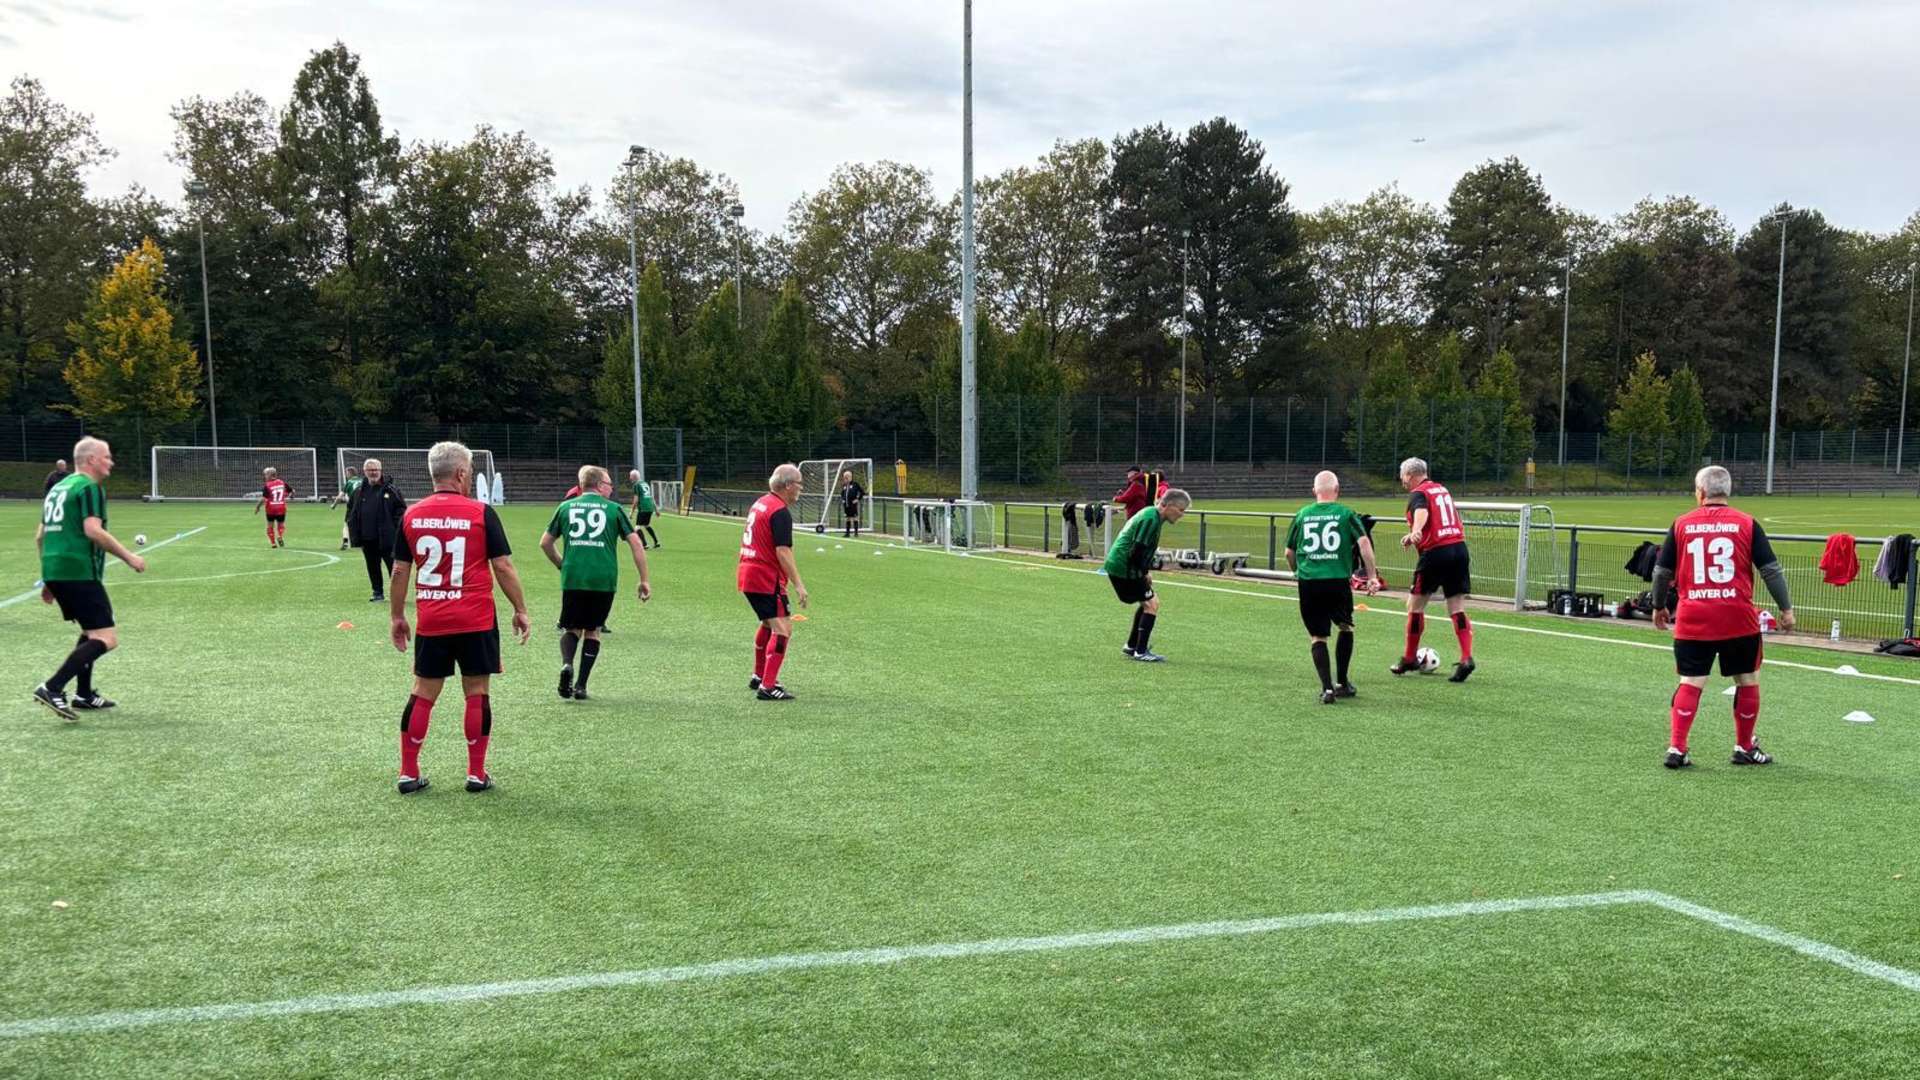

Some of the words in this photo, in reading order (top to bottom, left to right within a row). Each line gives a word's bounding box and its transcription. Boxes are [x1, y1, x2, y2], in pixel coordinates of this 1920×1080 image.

[271, 490, 284, 502] 17
[1435, 493, 1456, 527] 11
[411, 517, 471, 530] SILBERLÖWEN
[568, 508, 607, 538] 59
[1685, 522, 1740, 534] SILBERLÖWEN
[1303, 521, 1341, 552] 56
[416, 535, 466, 587] 21
[1686, 536, 1735, 585] 13
[417, 590, 447, 600] BAYER
[447, 590, 462, 599] 04
[1688, 589, 1720, 600] BAYER
[1721, 588, 1736, 598] 04
